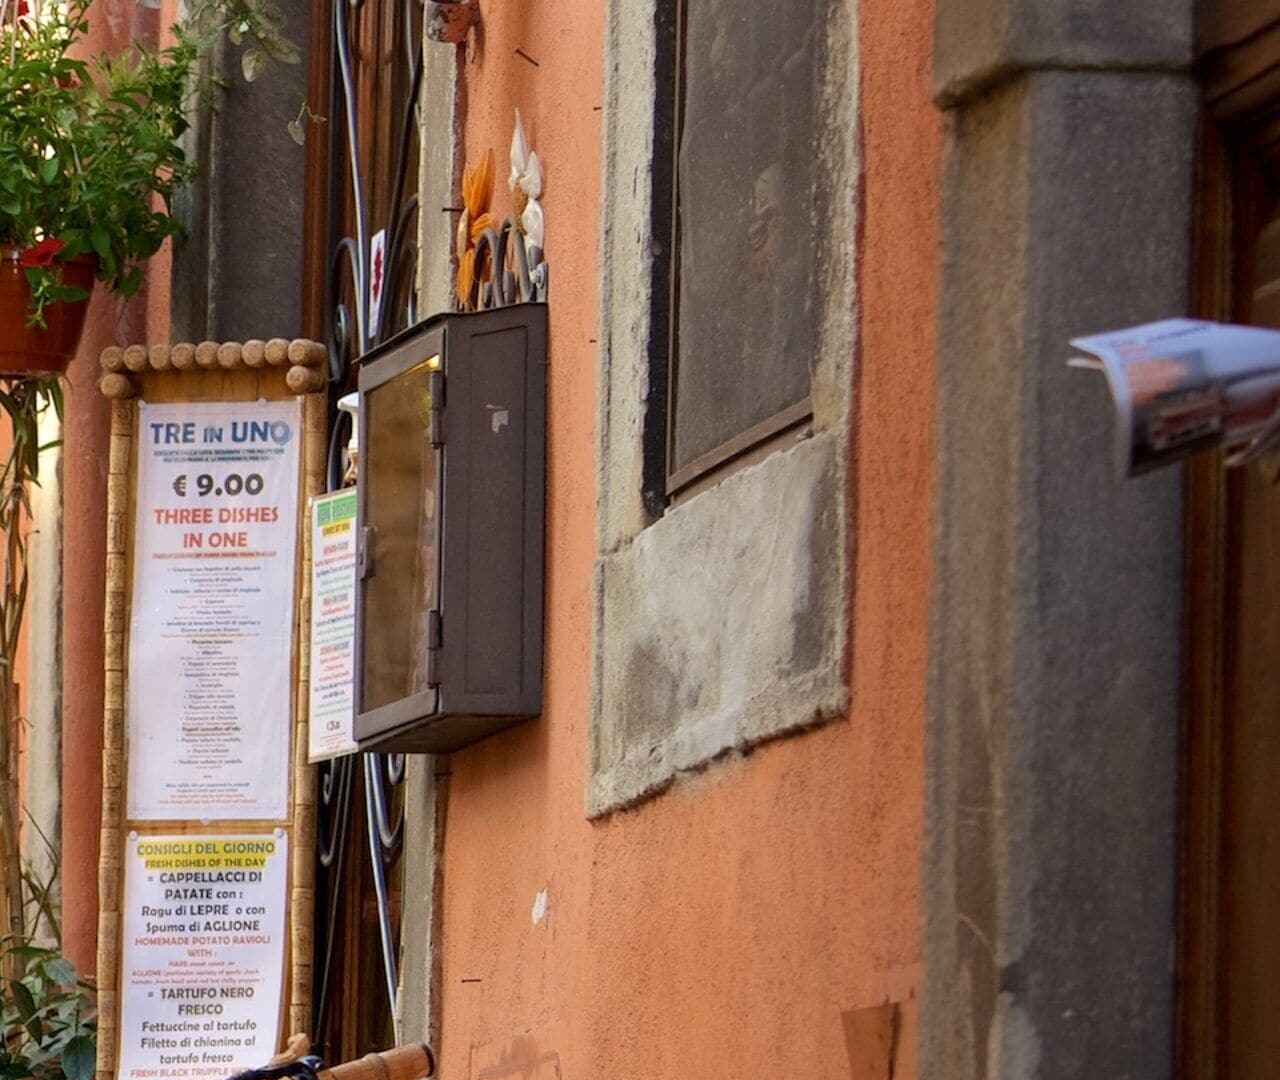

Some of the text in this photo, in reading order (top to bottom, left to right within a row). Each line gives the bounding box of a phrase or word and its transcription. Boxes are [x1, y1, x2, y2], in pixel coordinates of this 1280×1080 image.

[151, 420, 292, 445] TRE IN UNO
[173, 473, 264, 496] € 9.00
[154, 507, 278, 524] THREE DISHES
[184, 532, 247, 547] IN ONE
[137, 843, 275, 855] CONSIGLI DEL GIORNO
[145, 860, 174, 868] FRESH
[175, 859, 205, 867] DISHES
[245, 858, 265, 866] DAY
[160, 872, 262, 883] CAPPELLACCI DI
[165, 889, 236, 900] PATATE con
[142, 905, 265, 918] Ragu di LEPRE o con
[147, 921, 259, 934] Spuma di AGLIONE
[135, 936, 270, 946] HOMEMADE POTATO RAVIOLI
[161, 987, 254, 999] TARTUFO NERO
[178, 1004, 223, 1015] FRESCO
[142, 1020, 257, 1032] Fettuccine al tartufo
[141, 1036, 255, 1048] Filetto di chianina al
[160, 1054, 233, 1064] tartufo fresco
[131, 1068, 229, 1078] FRESH BLACK TRUFFLE
